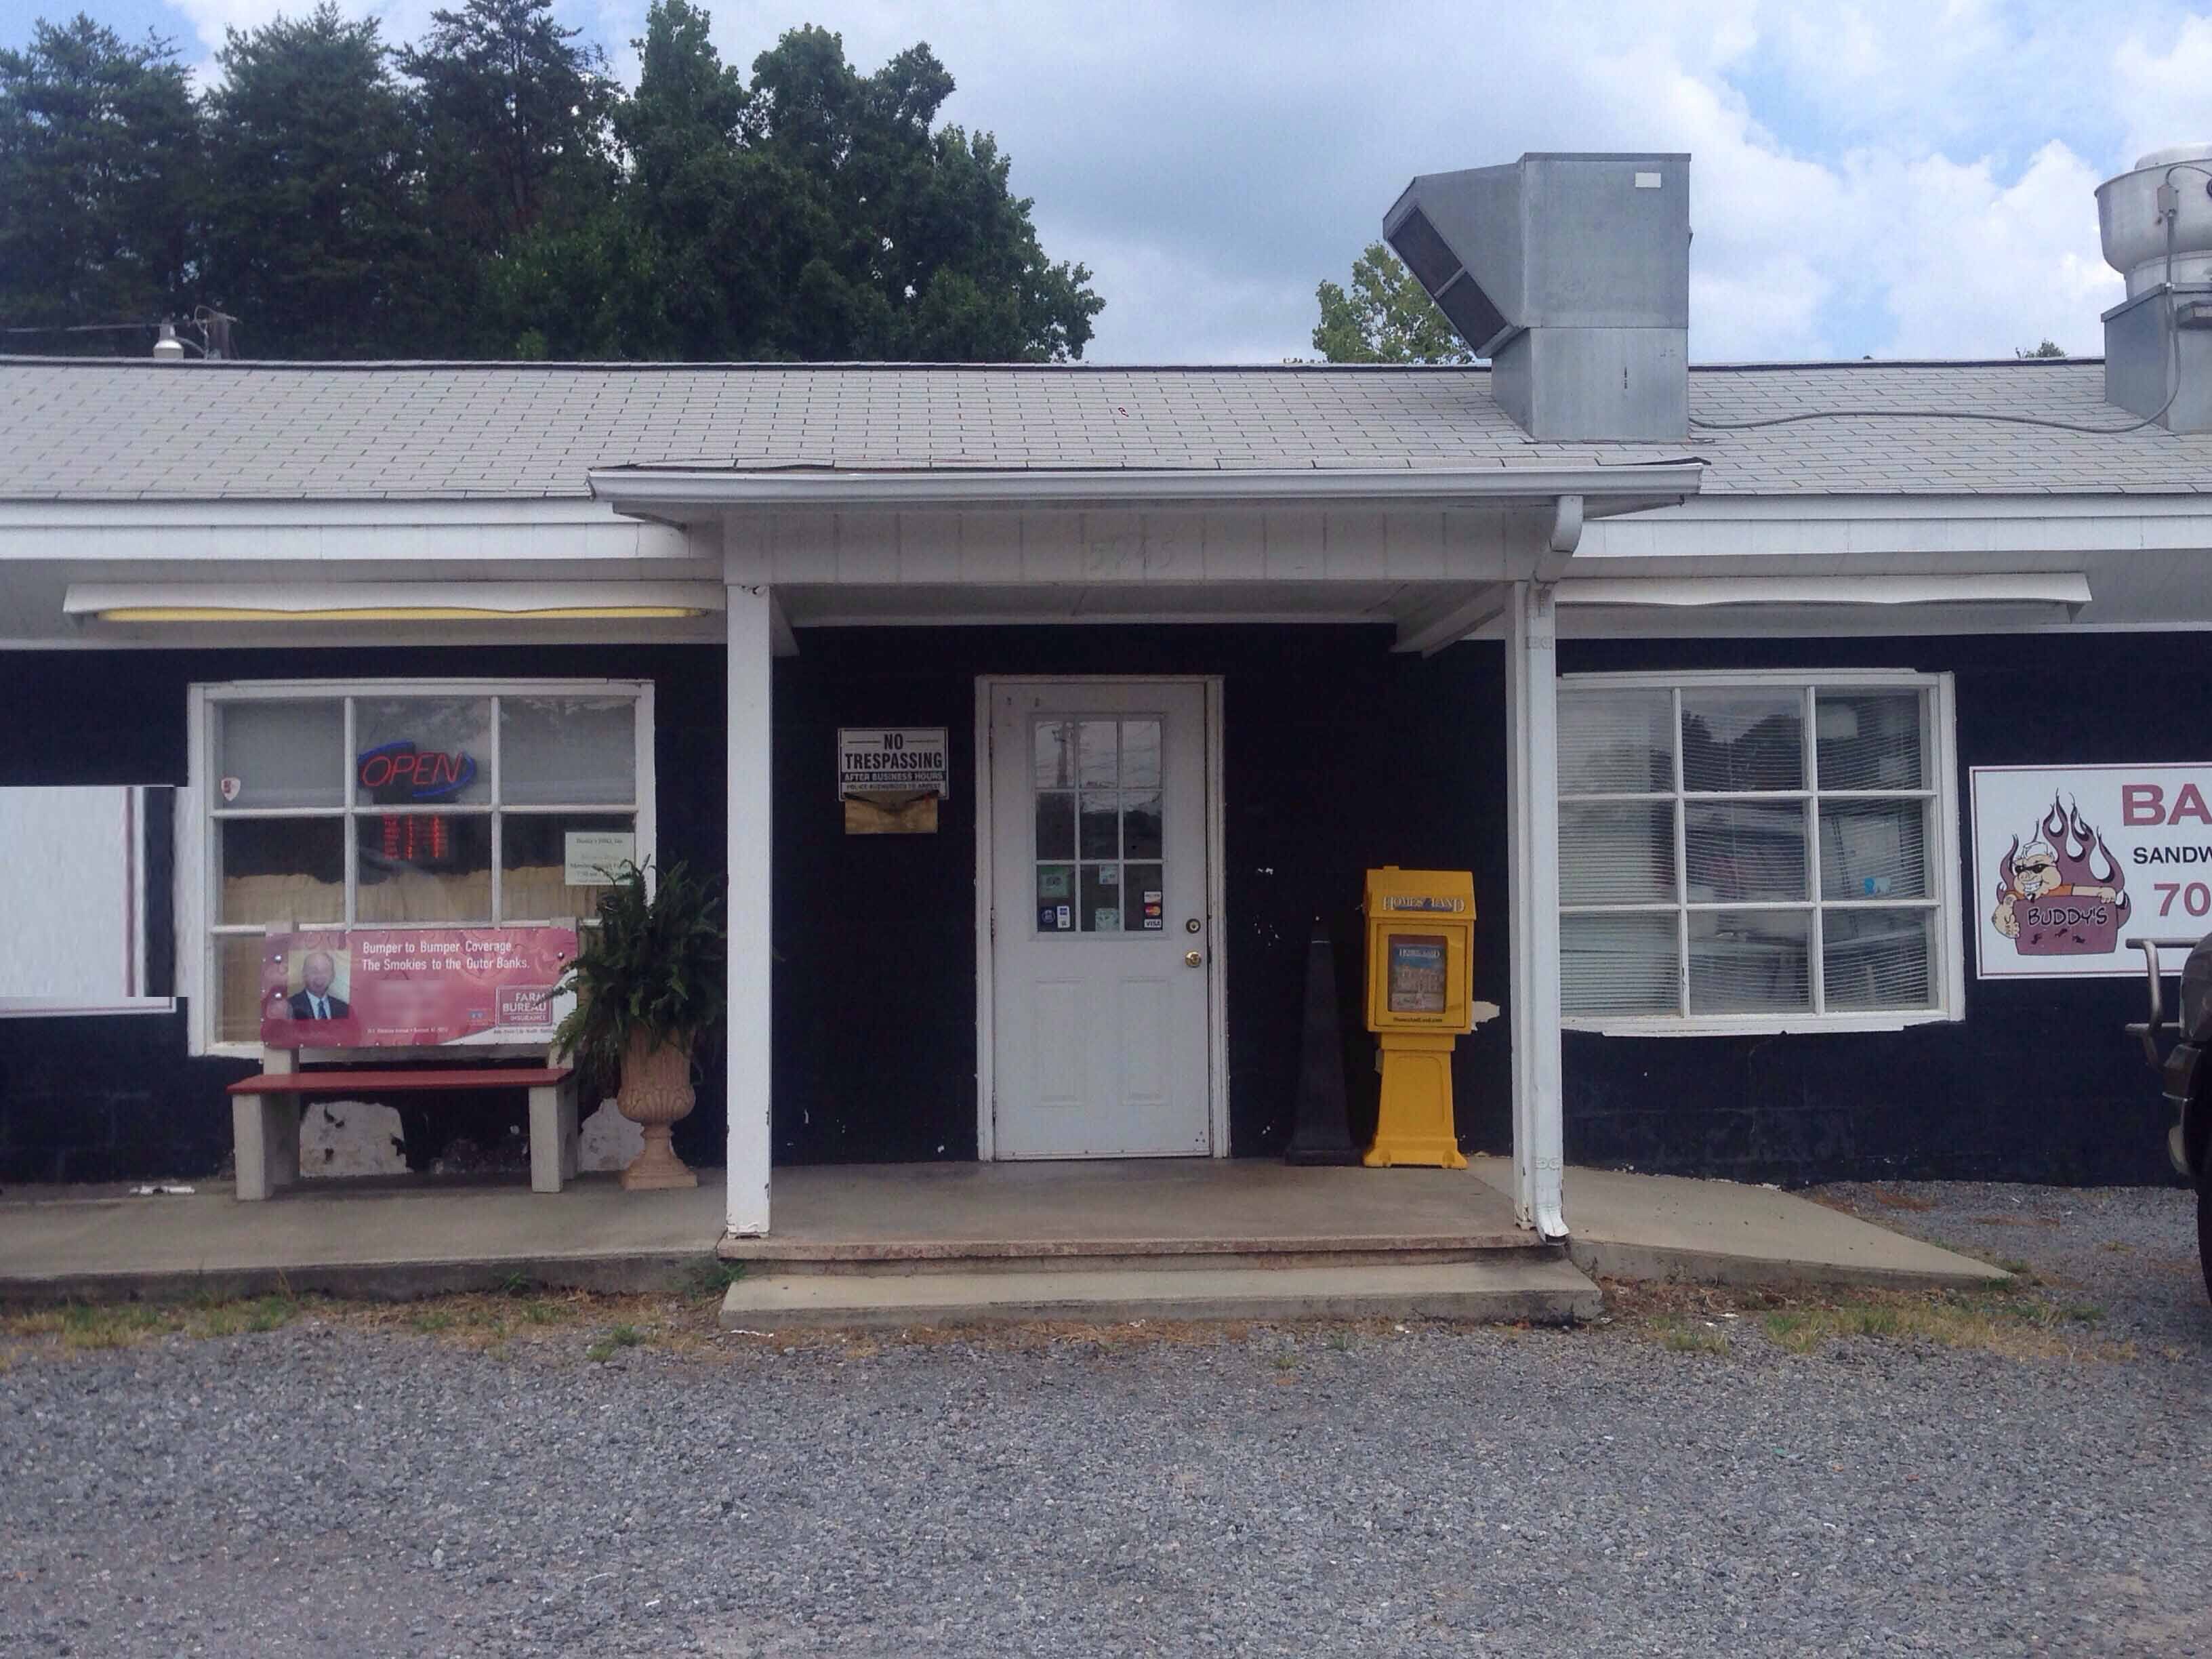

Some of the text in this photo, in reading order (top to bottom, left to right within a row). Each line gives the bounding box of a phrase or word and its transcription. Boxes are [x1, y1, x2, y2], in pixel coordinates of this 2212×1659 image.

[884, 733, 903, 750] NO
[362, 750, 464, 787] OPEN
[845, 752, 943, 769] TRESPASSING
[845, 772, 943, 781] AFTER BUSINESS HOURS
[2122, 783, 2212, 826] BA
[2133, 846, 2212, 864] SANDW
[1431, 897, 1465, 912] LAND
[2154, 882, 2211, 917] 70
[2028, 907, 2108, 926] BUDDY'S
[363, 941, 401, 956] Bumper
[405, 942, 415, 953] to
[420, 941, 460, 954] Bumper
[363, 956, 530, 970] The Smokies to the Outer Banks.
[503, 1003, 546, 1012] BUREAU
